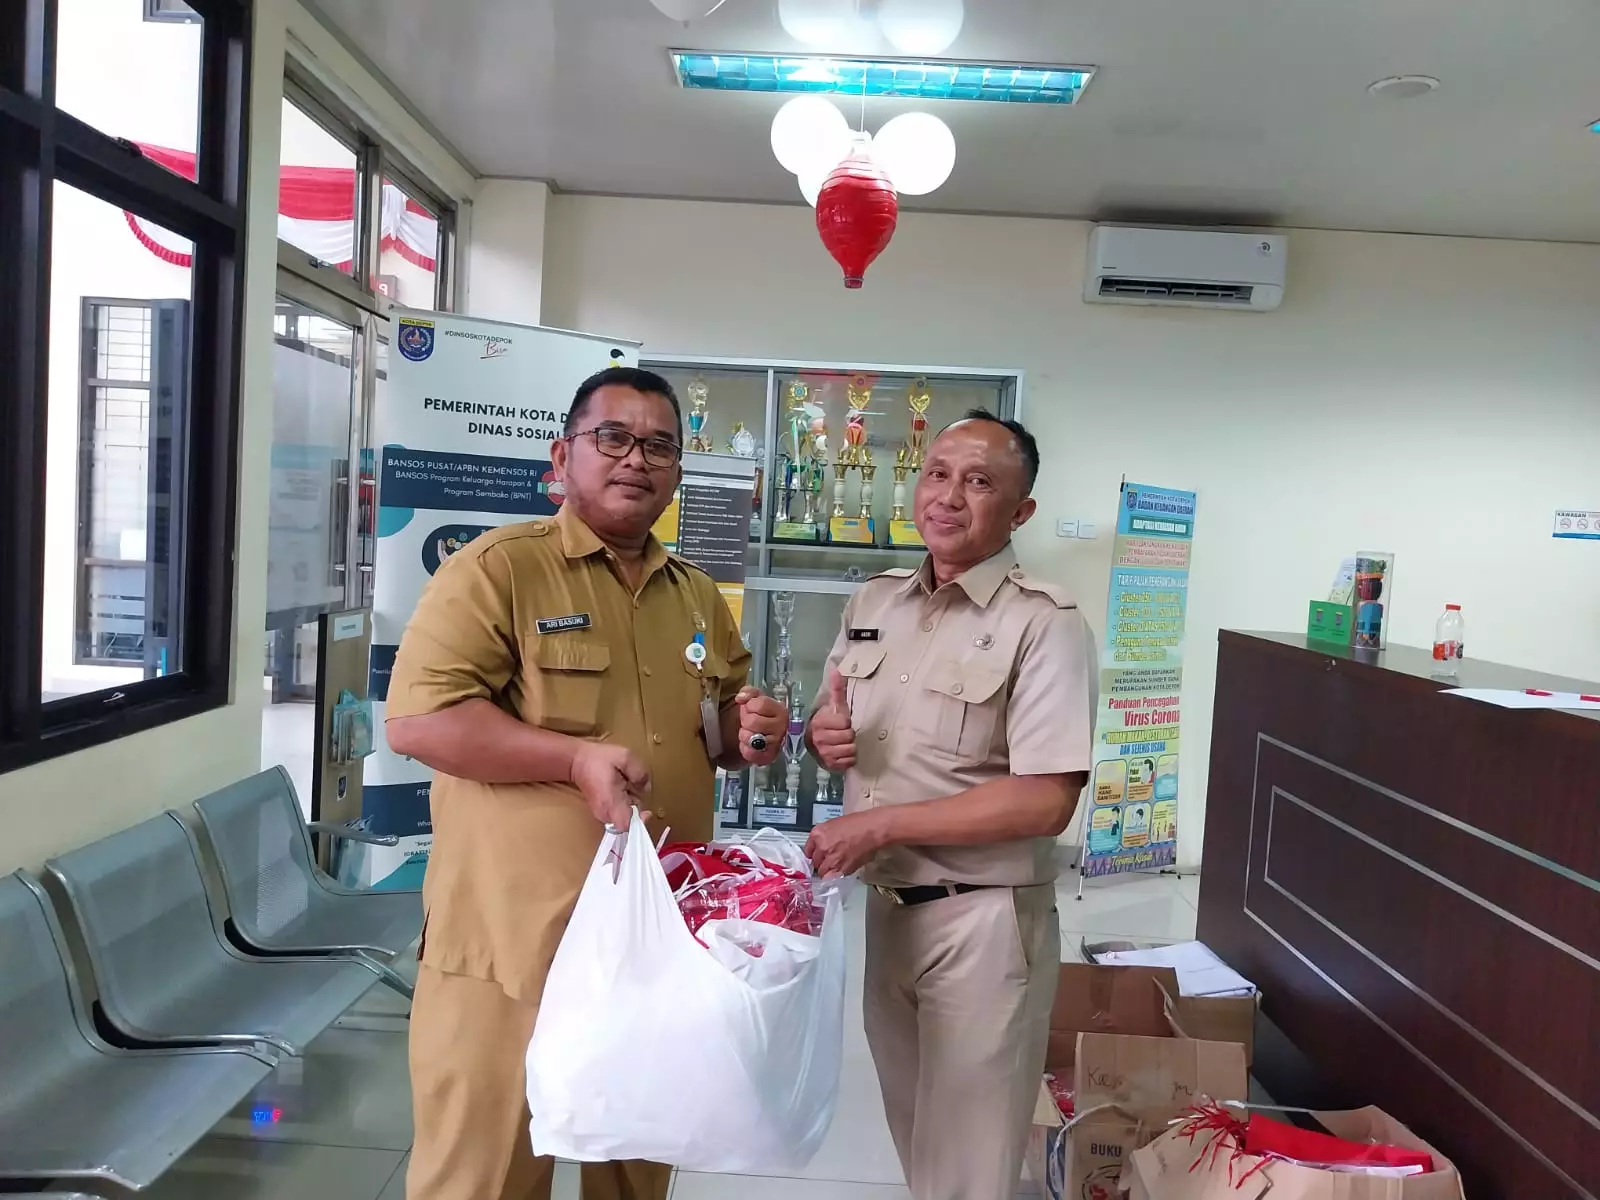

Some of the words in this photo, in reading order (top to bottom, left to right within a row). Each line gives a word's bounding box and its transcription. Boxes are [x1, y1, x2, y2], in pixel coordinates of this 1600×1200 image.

[444, 330, 513, 344] #DINSOSKOTADEPOK
[424, 397, 516, 418] PEMERINTAH
[520, 408, 556, 423] KOTA
[468, 422, 513, 437] DINAS
[387, 458, 425, 469] BANSOS
[427, 461, 479, 473] PUSAT/APBN
[482, 466, 528, 477] KEMENSOS
[529, 469, 538, 477] RI
[395, 471, 428, 480] BANSOS
[430, 474, 461, 485] Program
[462, 476, 494, 487] Keluarga
[496, 478, 525, 488] Harapan
[443, 487, 474, 498] Program
[475, 489, 509, 499] Sembako
[510, 491, 532, 501] (BPNT)
[546, 621, 558, 629] ARI
[558, 617, 584, 627] BASUKI
[1108, 697, 1141, 709] Panduan
[1124, 711, 1150, 727] Virus
[1090, 1143, 1123, 1158] BUKU
